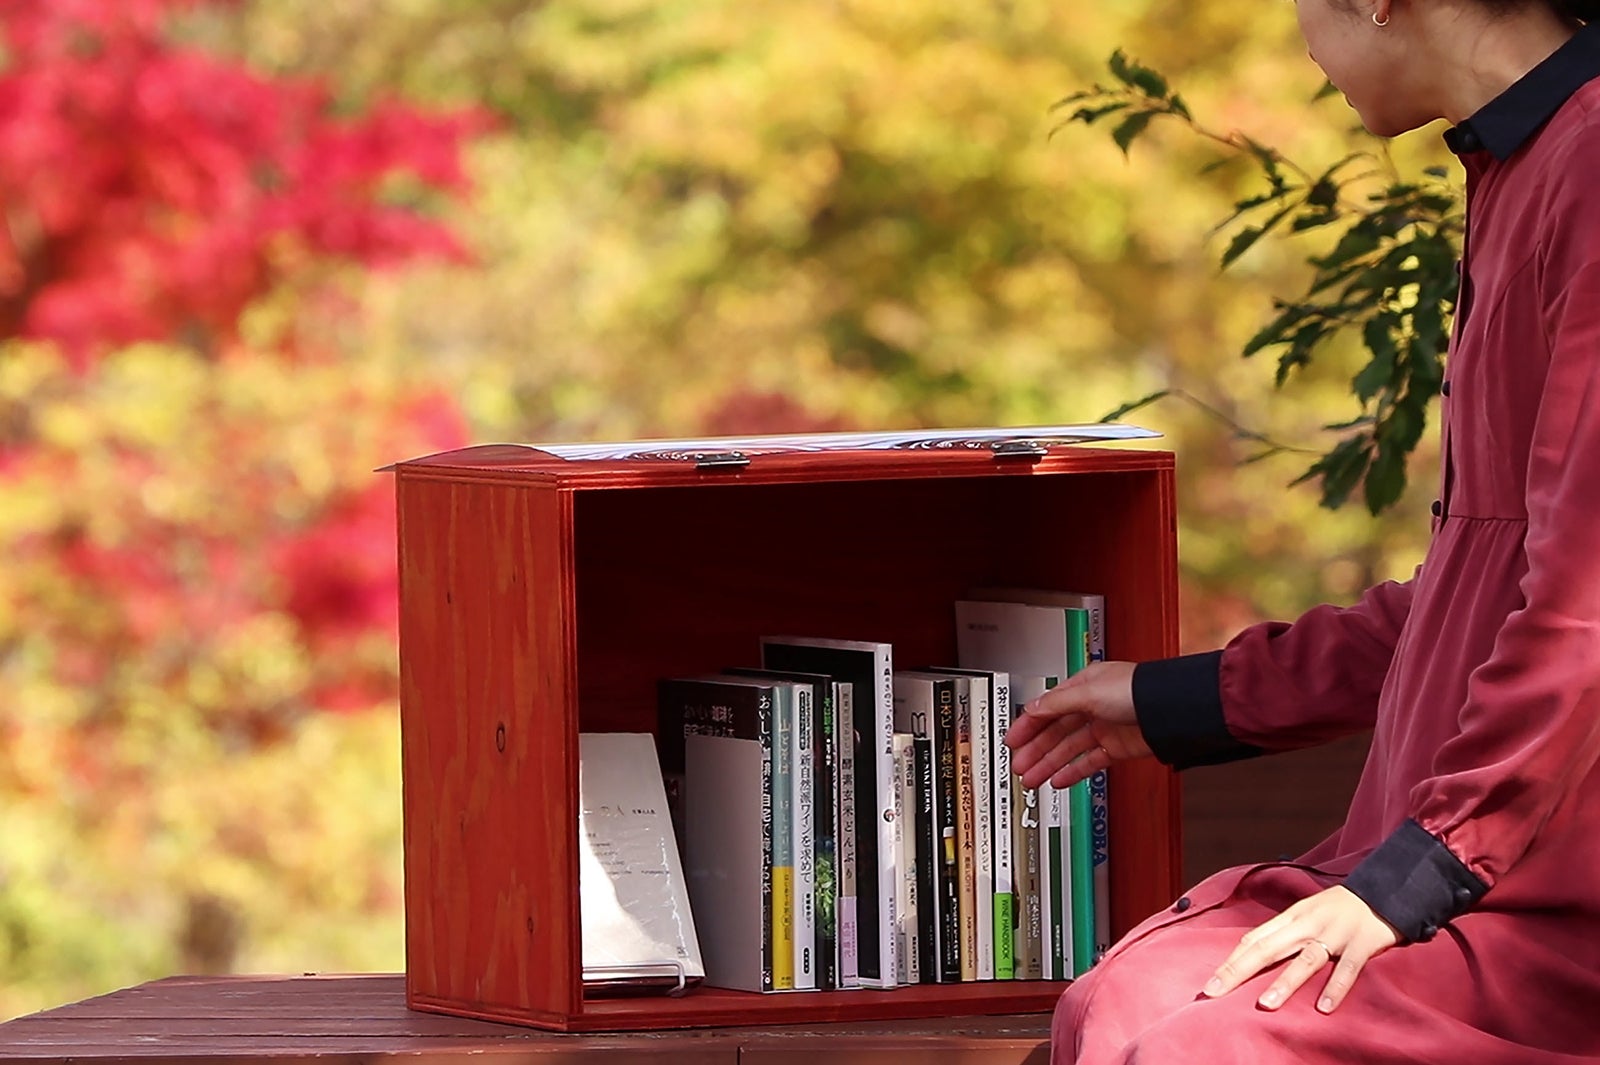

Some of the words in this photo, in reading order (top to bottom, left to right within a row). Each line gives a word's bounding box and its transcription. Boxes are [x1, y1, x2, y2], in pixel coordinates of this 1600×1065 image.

[842, 758, 854, 880] 酵素玄米どんぶり
[1092, 804, 1107, 867] SOBA
